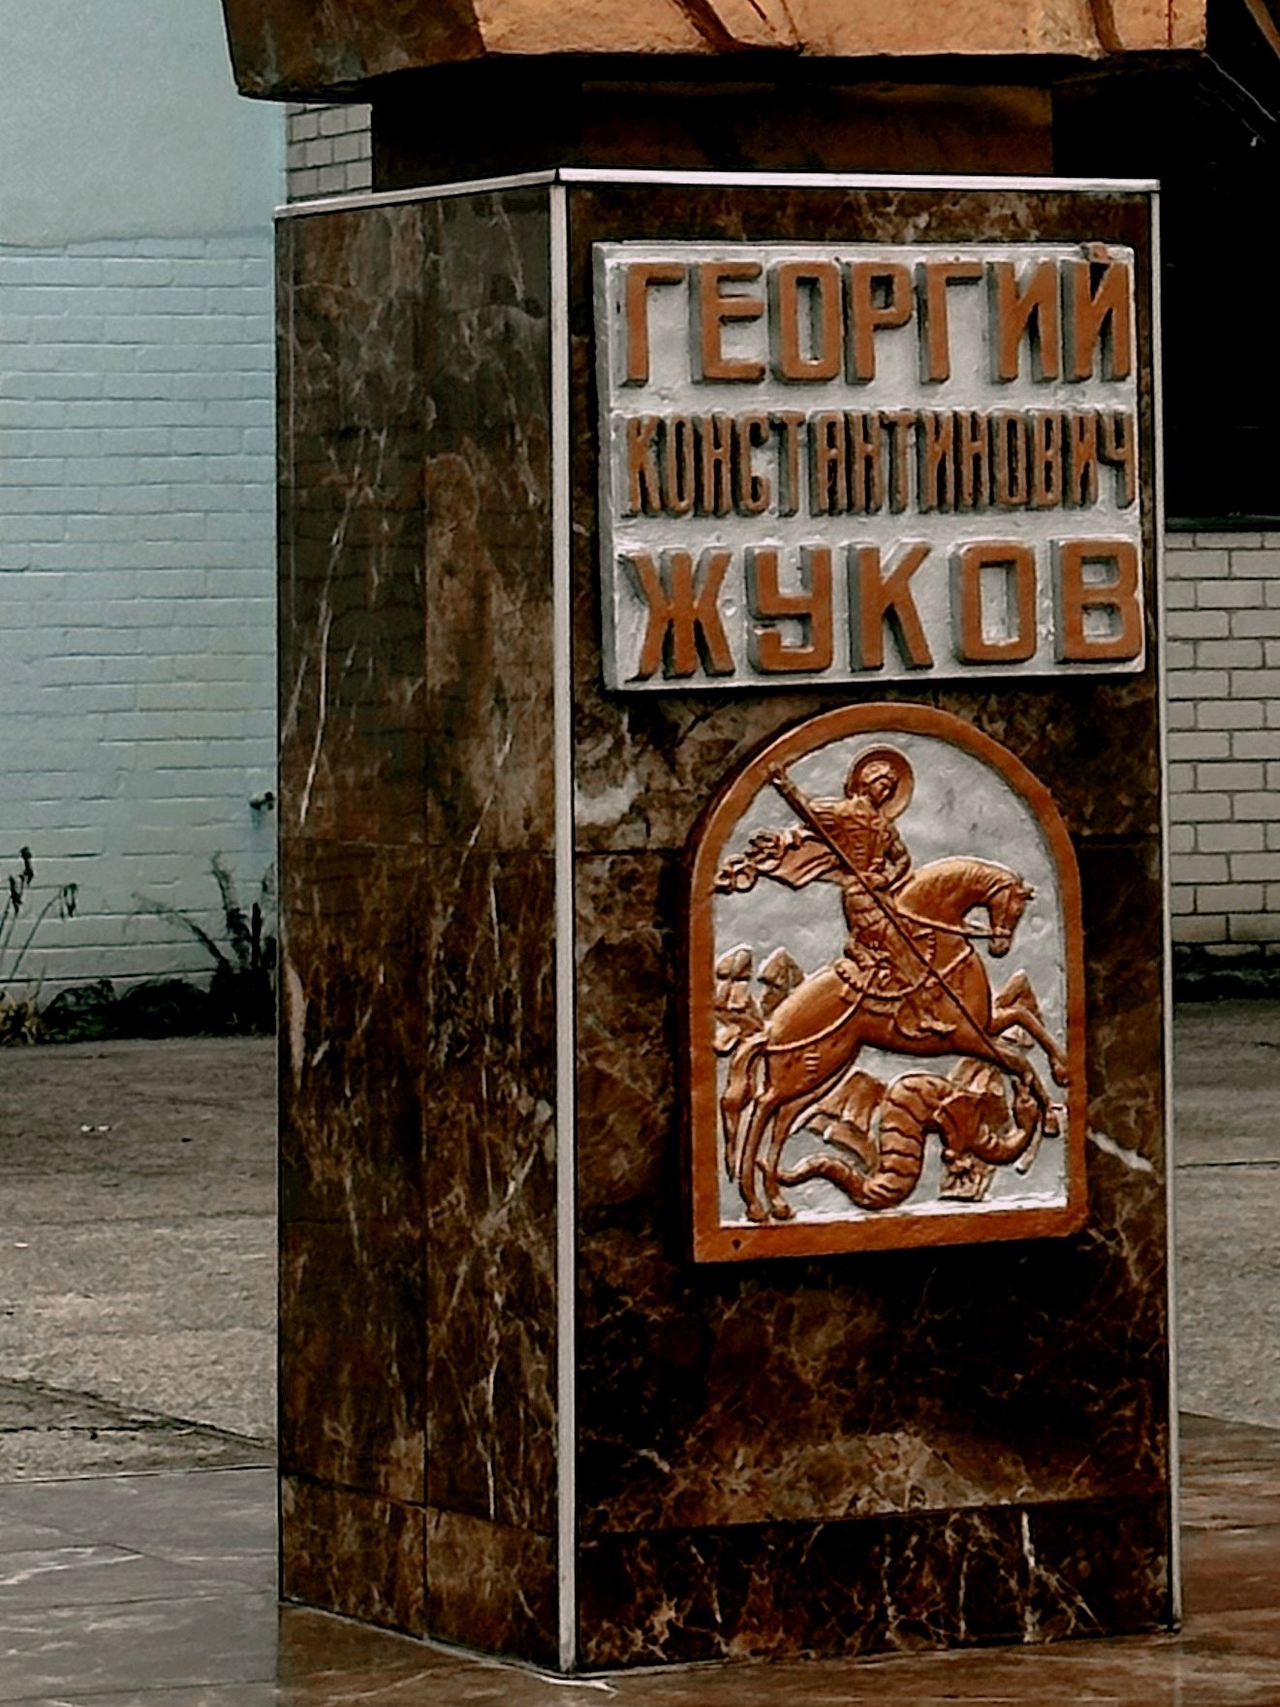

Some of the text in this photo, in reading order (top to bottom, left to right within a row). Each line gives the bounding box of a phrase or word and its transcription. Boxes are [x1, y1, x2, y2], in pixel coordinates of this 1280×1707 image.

[618, 242, 1132, 385] ГЕОРГИЙ
[622, 411, 1134, 517] КОНСТАНТИНОВИЧ
[622, 540, 1142, 681] ЖУКОВ
